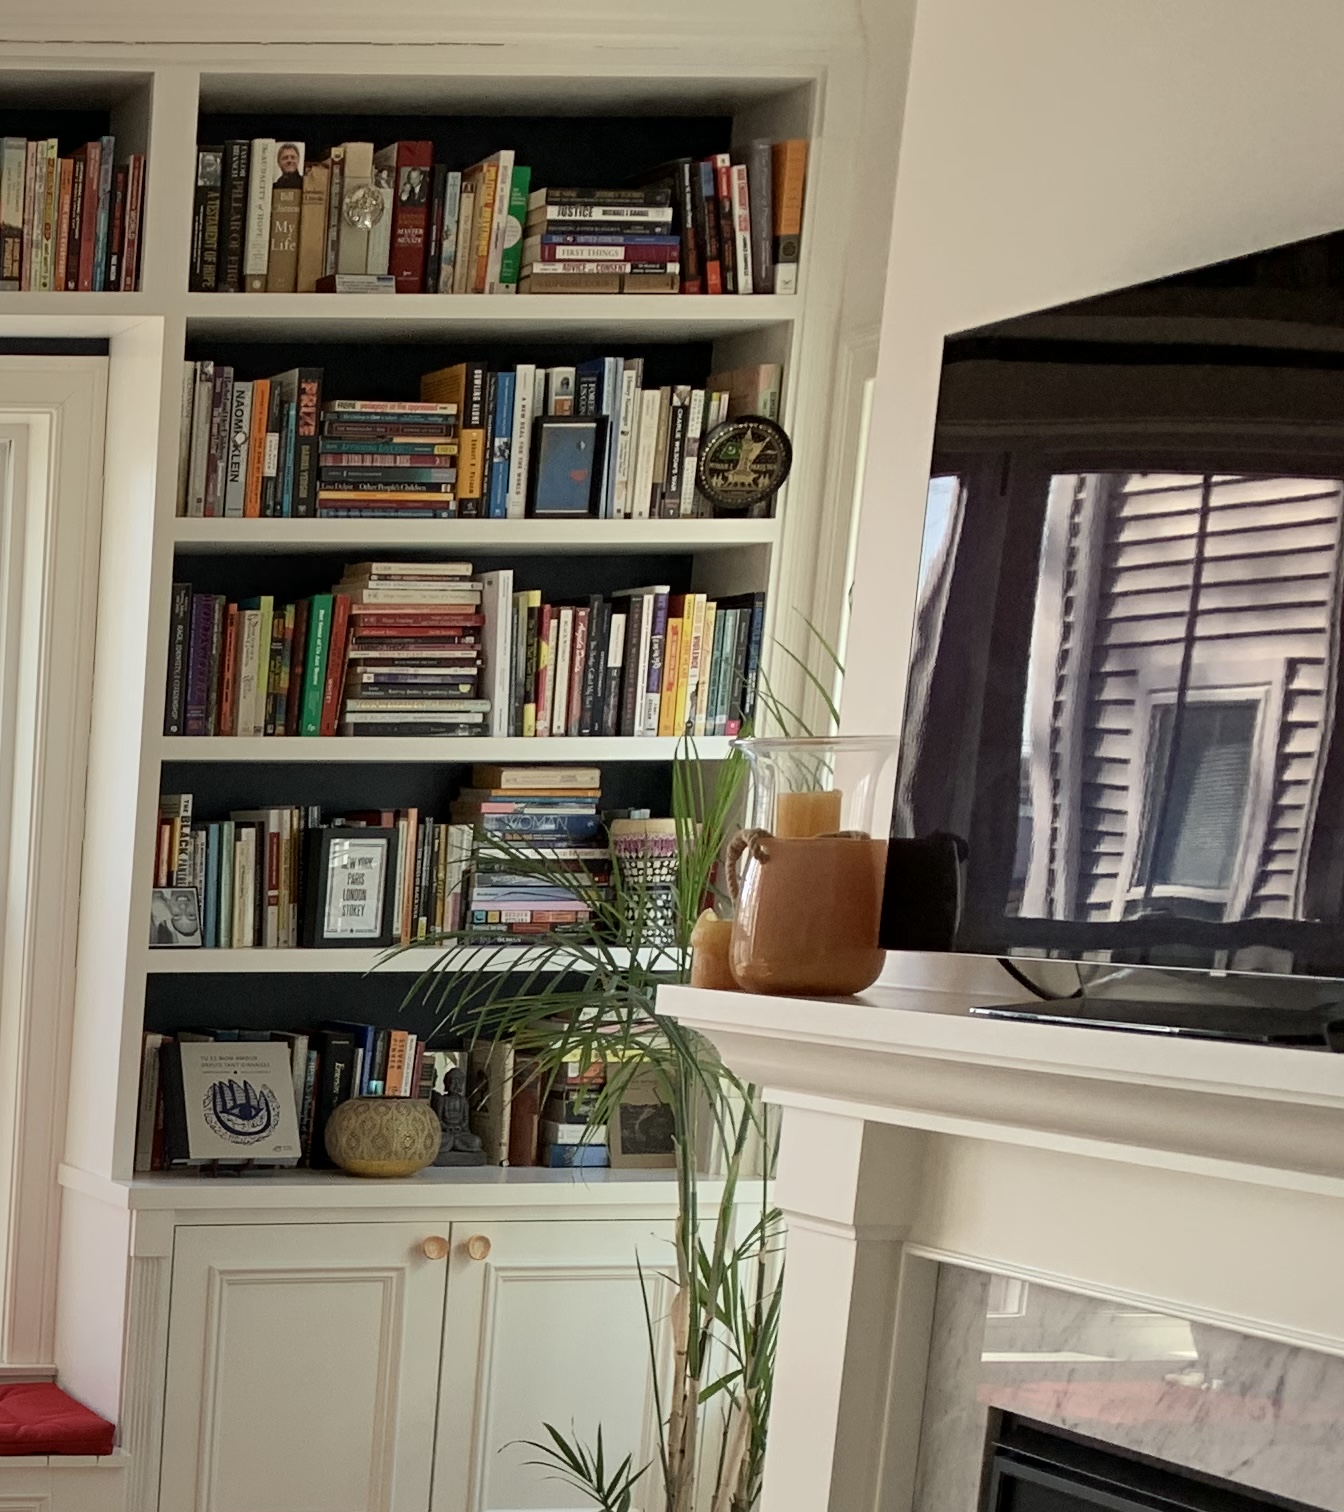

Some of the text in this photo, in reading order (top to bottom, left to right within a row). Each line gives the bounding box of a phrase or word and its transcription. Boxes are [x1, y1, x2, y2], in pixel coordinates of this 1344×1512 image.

[230, 180, 244, 230] PILLAR
[557, 206, 593, 217] JUSTICE
[205, 200, 219, 248] TESTAMENT
[275, 221, 295, 234] My
[229, 233, 239, 248] OF
[271, 239, 296, 251] Life
[204, 251, 216, 263] OF
[202, 265, 216, 287] HOPE
[298, 380, 318, 436] PRIZE
[674, 408, 684, 439] CHARLIE
[229, 444, 241, 483] KLEIN
[670, 475, 678, 492] WAR
[691, 636, 701, 669] VIOLENCE
[504, 816, 568, 830] WOMAN
[179, 815, 190, 855] BLACK
[347, 872, 365, 885] PARIS
[343, 889, 367, 901] LONDON
[396, 1039, 405, 1070] STEVEN
